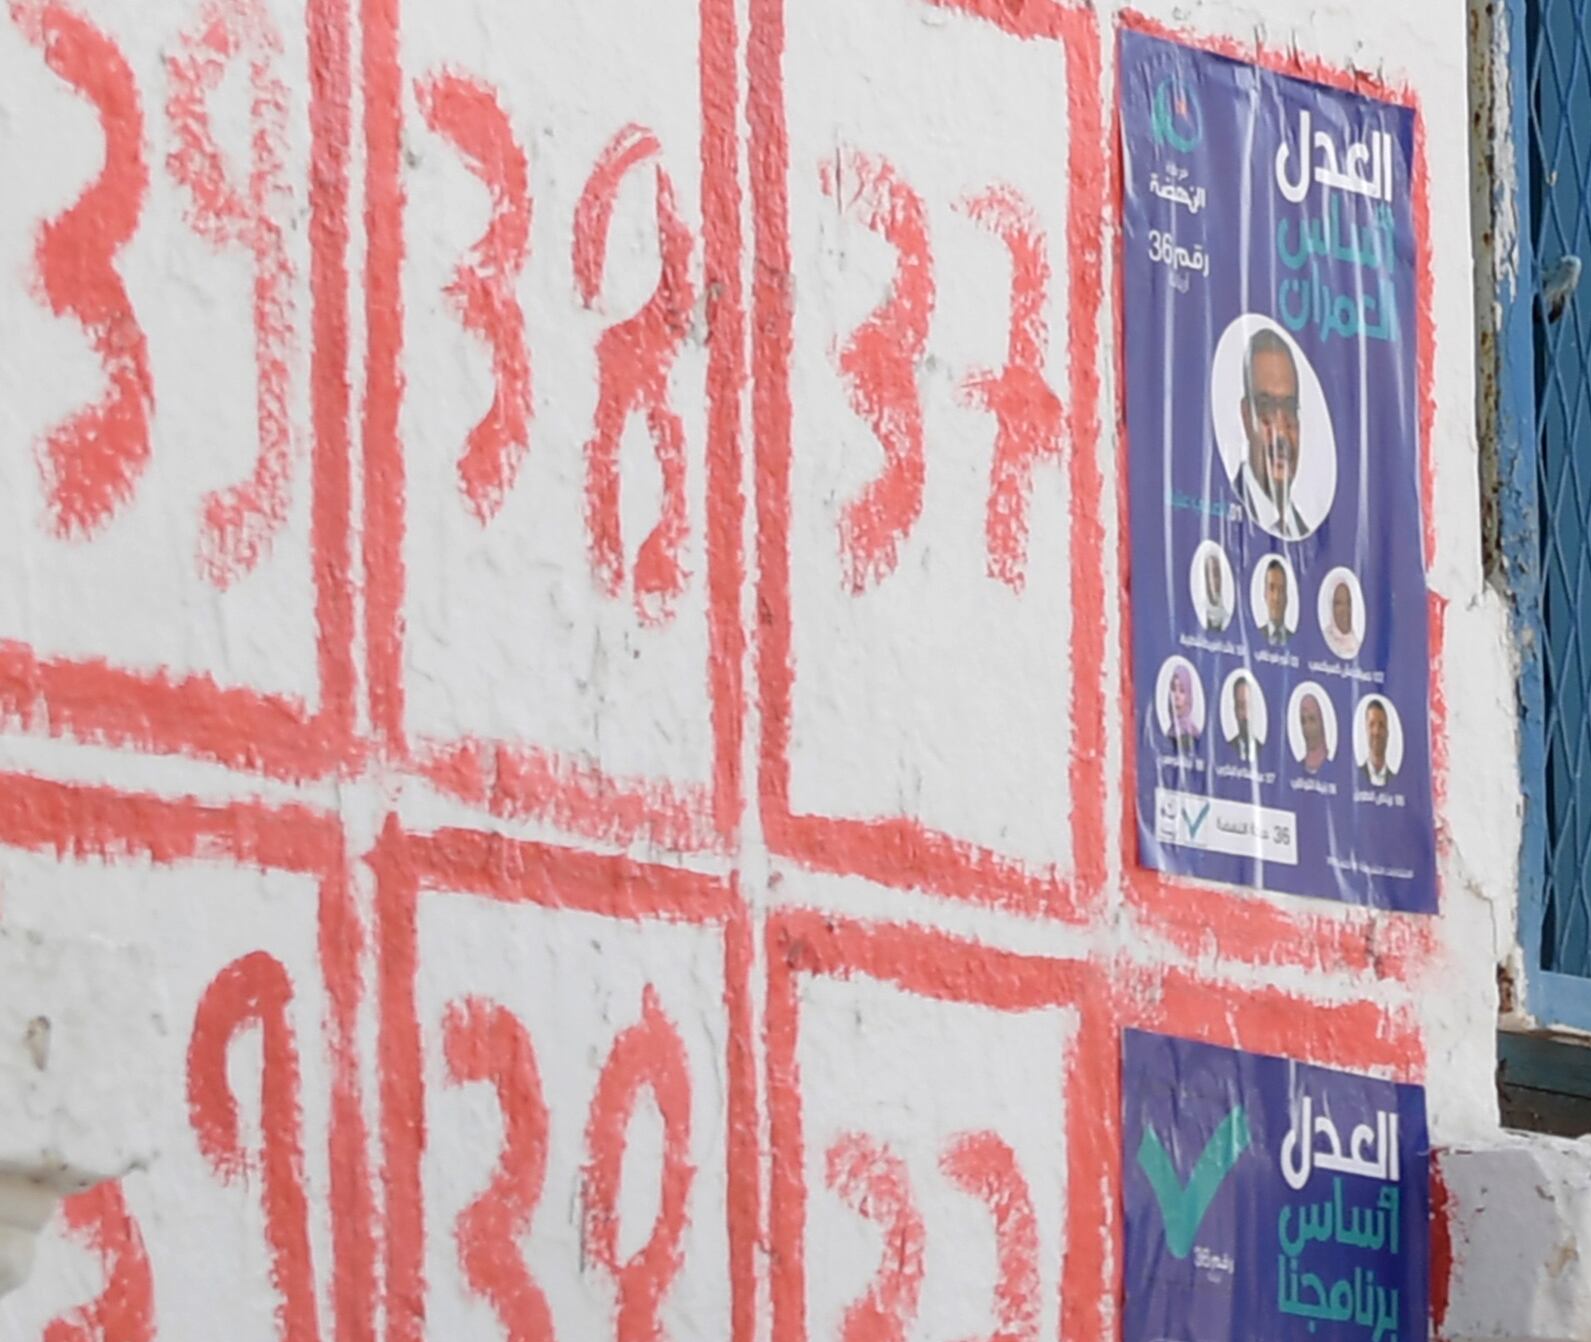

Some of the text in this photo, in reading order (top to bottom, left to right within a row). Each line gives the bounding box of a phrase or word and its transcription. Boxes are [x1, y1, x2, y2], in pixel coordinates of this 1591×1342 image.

[1276, 109, 1393, 203] العدل
[10, 0, 295, 592] 39
[413, 62, 696, 628] 38
[818, 142, 1064, 597] 37
[1279, 1176, 1399, 1254] أساس
[1280, 1096, 1399, 1190] العدل
